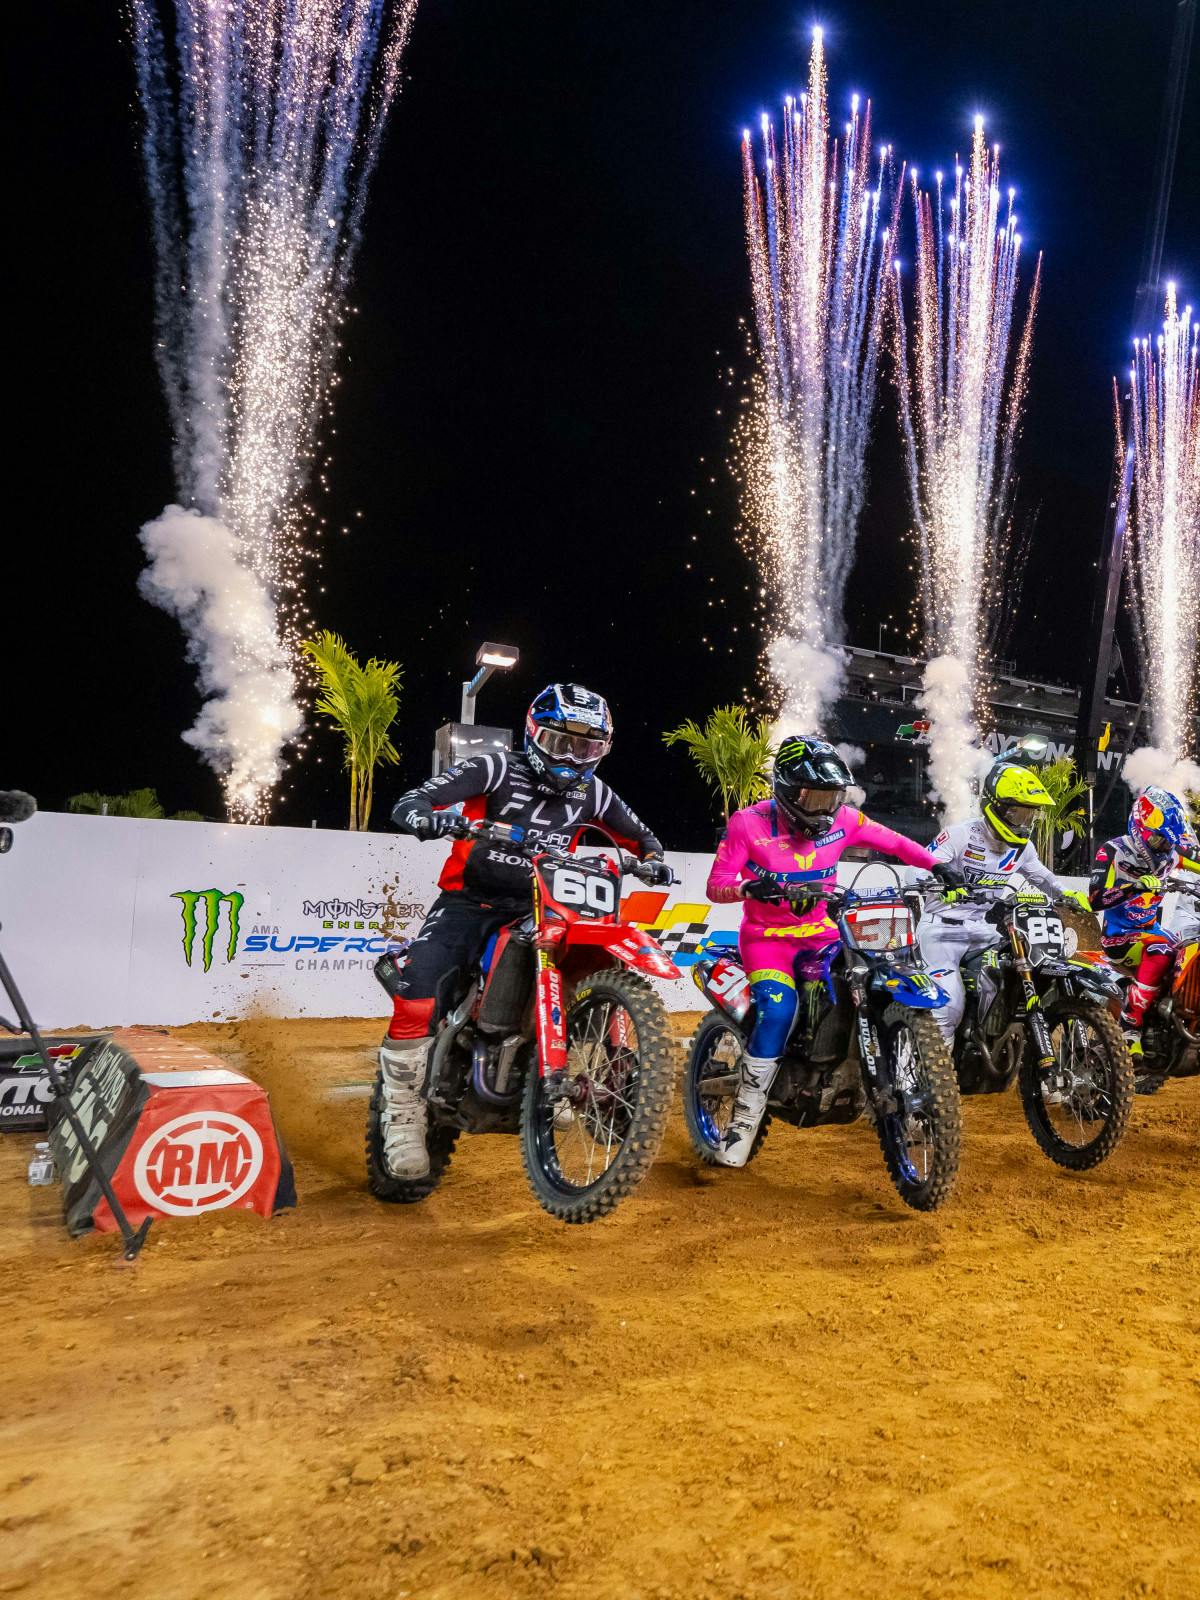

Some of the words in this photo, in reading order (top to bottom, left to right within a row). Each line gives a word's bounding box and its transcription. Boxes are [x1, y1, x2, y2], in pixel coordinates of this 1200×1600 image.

[499, 792, 584, 827] FLY
[822, 829, 844, 845] YAMAHA
[486, 850, 533, 868] HON
[553, 868, 614, 913] 60
[251, 924, 281, 935] AMA
[1027, 916, 1064, 945] 83
[295, 959, 376, 971] CHAMPIO
[706, 963, 751, 1002] 31
[549, 970, 563, 1038] DUNLP
[161, 1140, 243, 1188] RM
